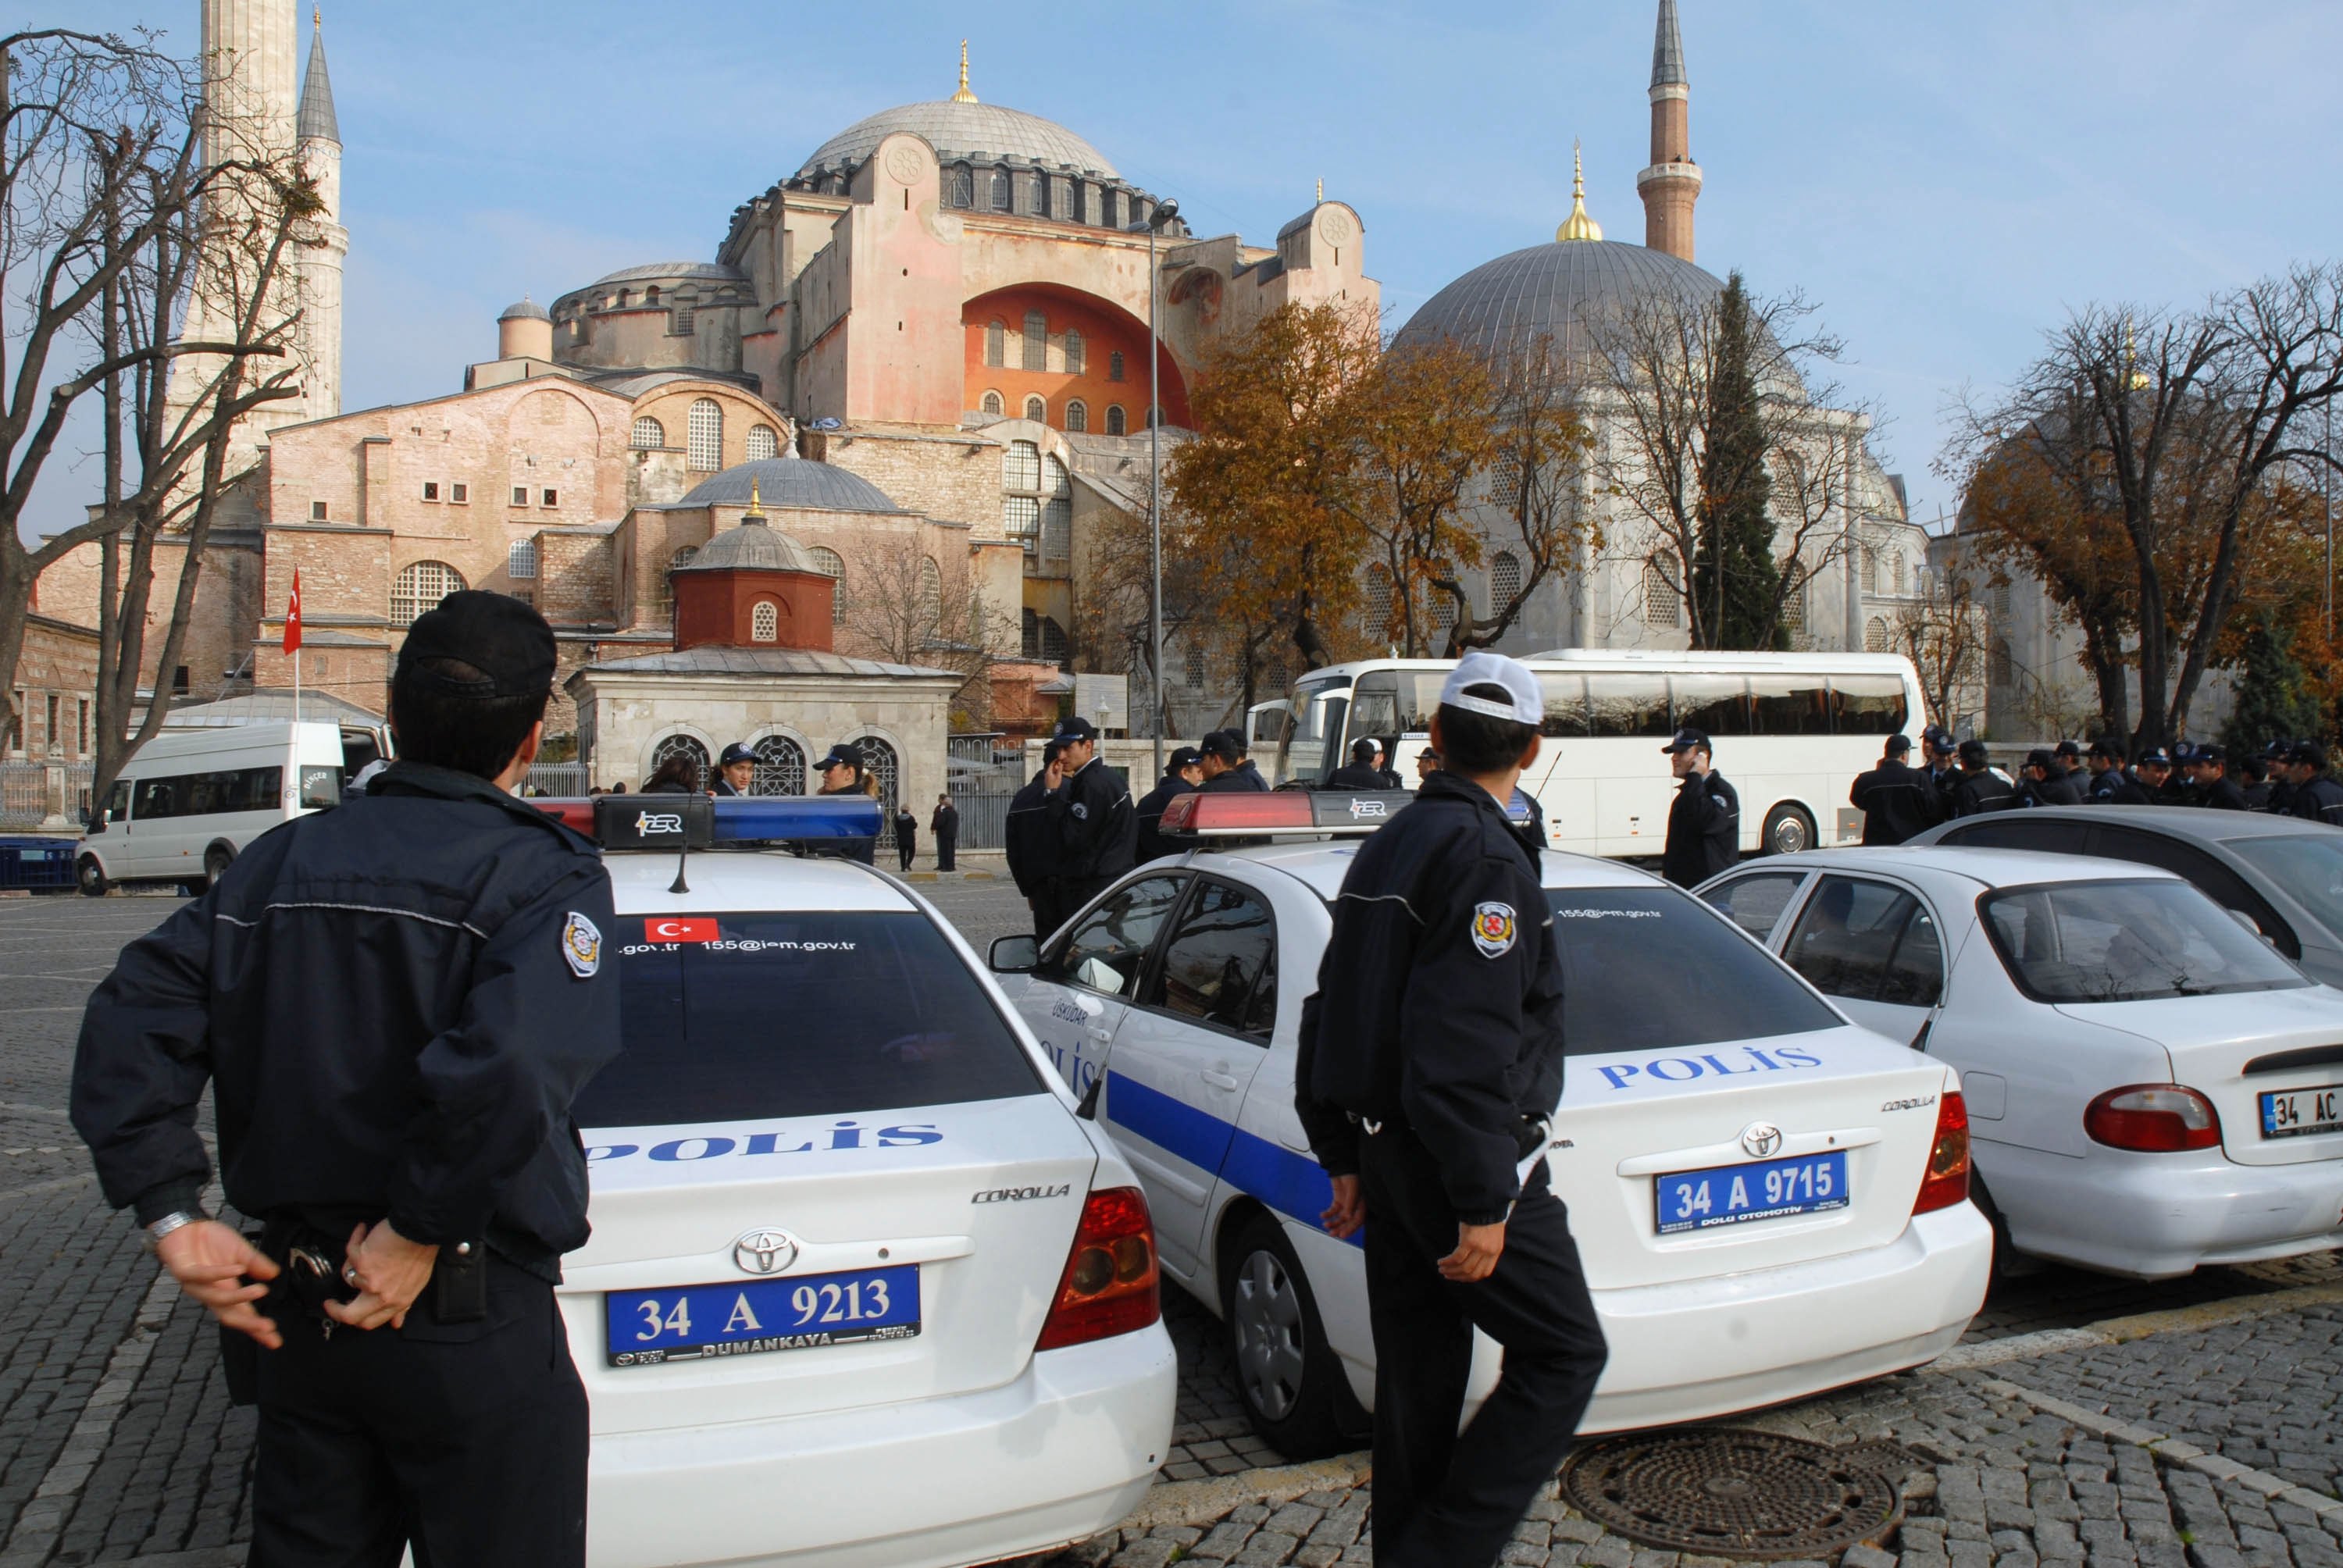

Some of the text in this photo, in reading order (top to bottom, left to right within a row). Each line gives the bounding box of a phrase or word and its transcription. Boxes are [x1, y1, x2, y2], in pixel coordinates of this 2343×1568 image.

[1881, 1096, 1935, 1112] COROLLA
[2276, 1092, 2337, 1124] 34 AC
[971, 1184, 1071, 1203] COROLLA
[1676, 1162, 1832, 1218] 34 A 9715
[636, 1278, 890, 1342] 34 A 9213
[702, 1332, 832, 1357] DUMANKAYA
